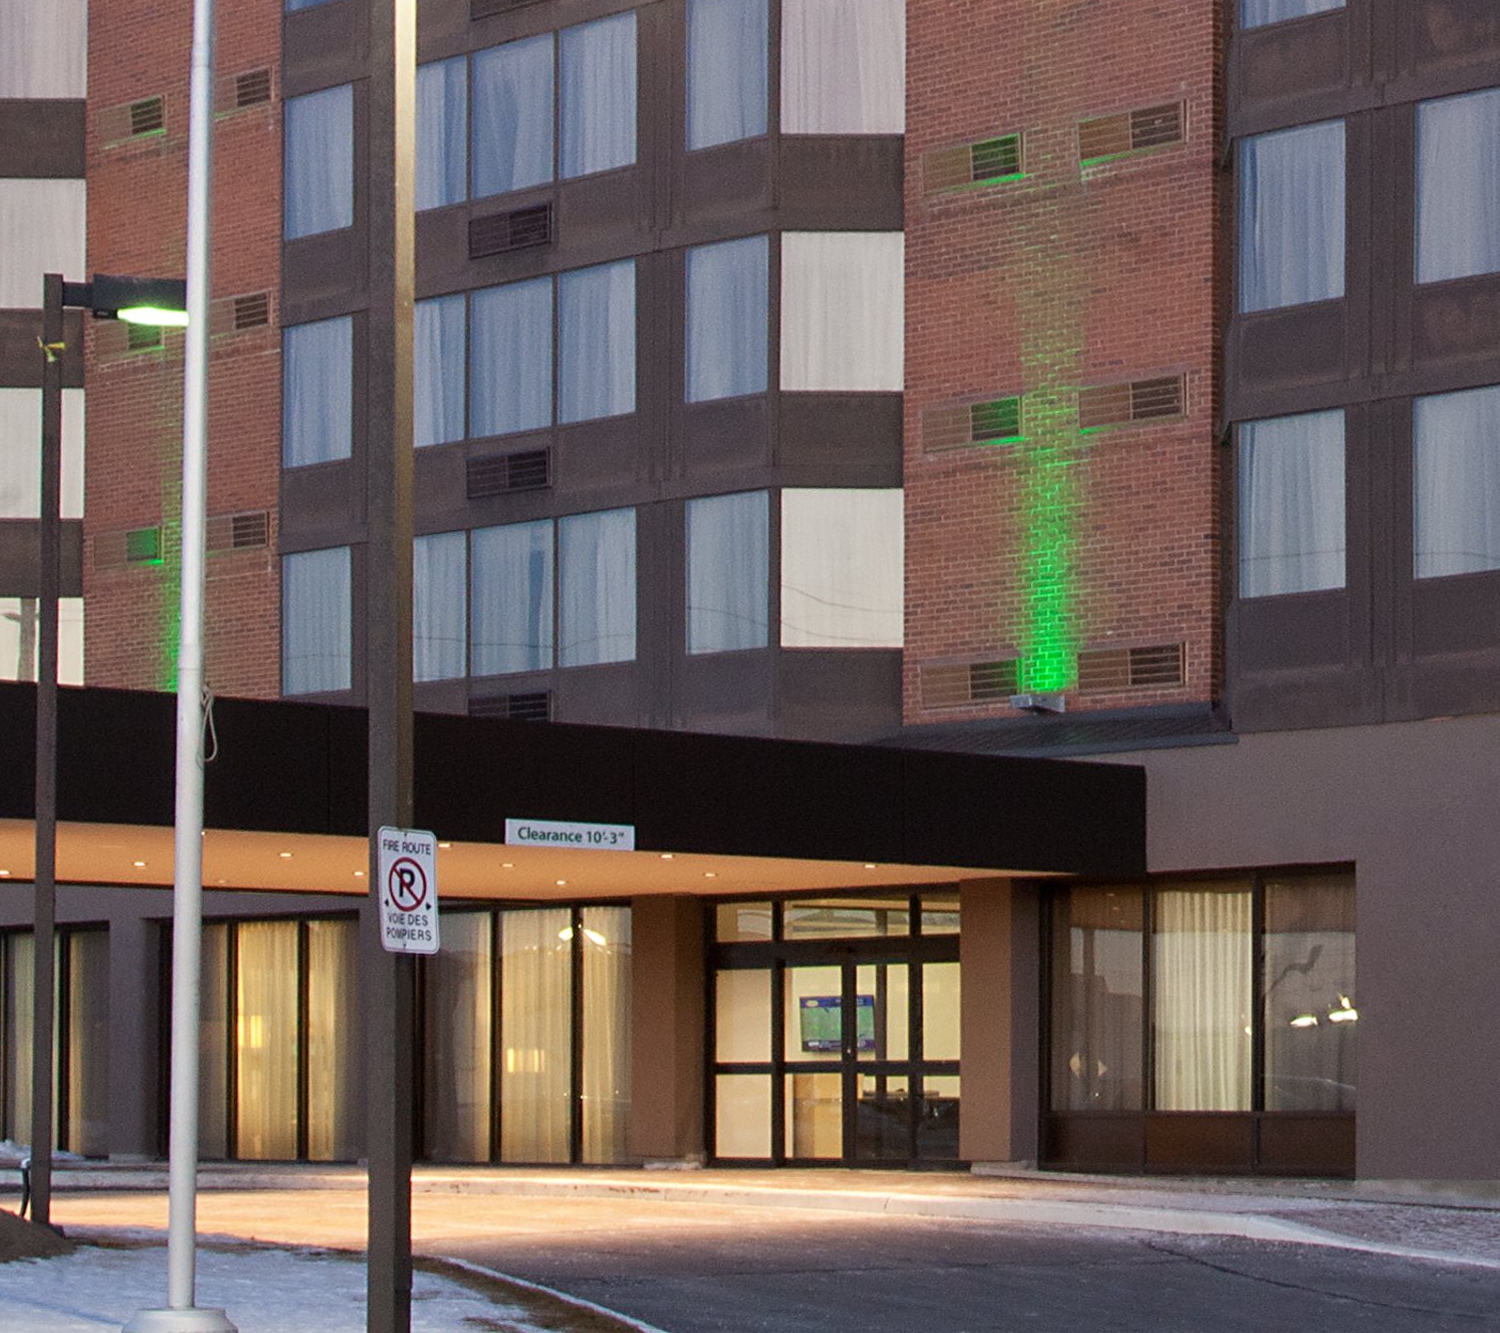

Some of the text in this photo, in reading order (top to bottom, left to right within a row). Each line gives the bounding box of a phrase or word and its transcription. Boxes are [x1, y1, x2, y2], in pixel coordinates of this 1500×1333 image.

[517, 826, 583, 843] Clearance
[382, 838, 432, 855] FIRE ROUTE
[387, 913, 429, 927] VOIE DES
[386, 927, 433, 942] POMPIERS
